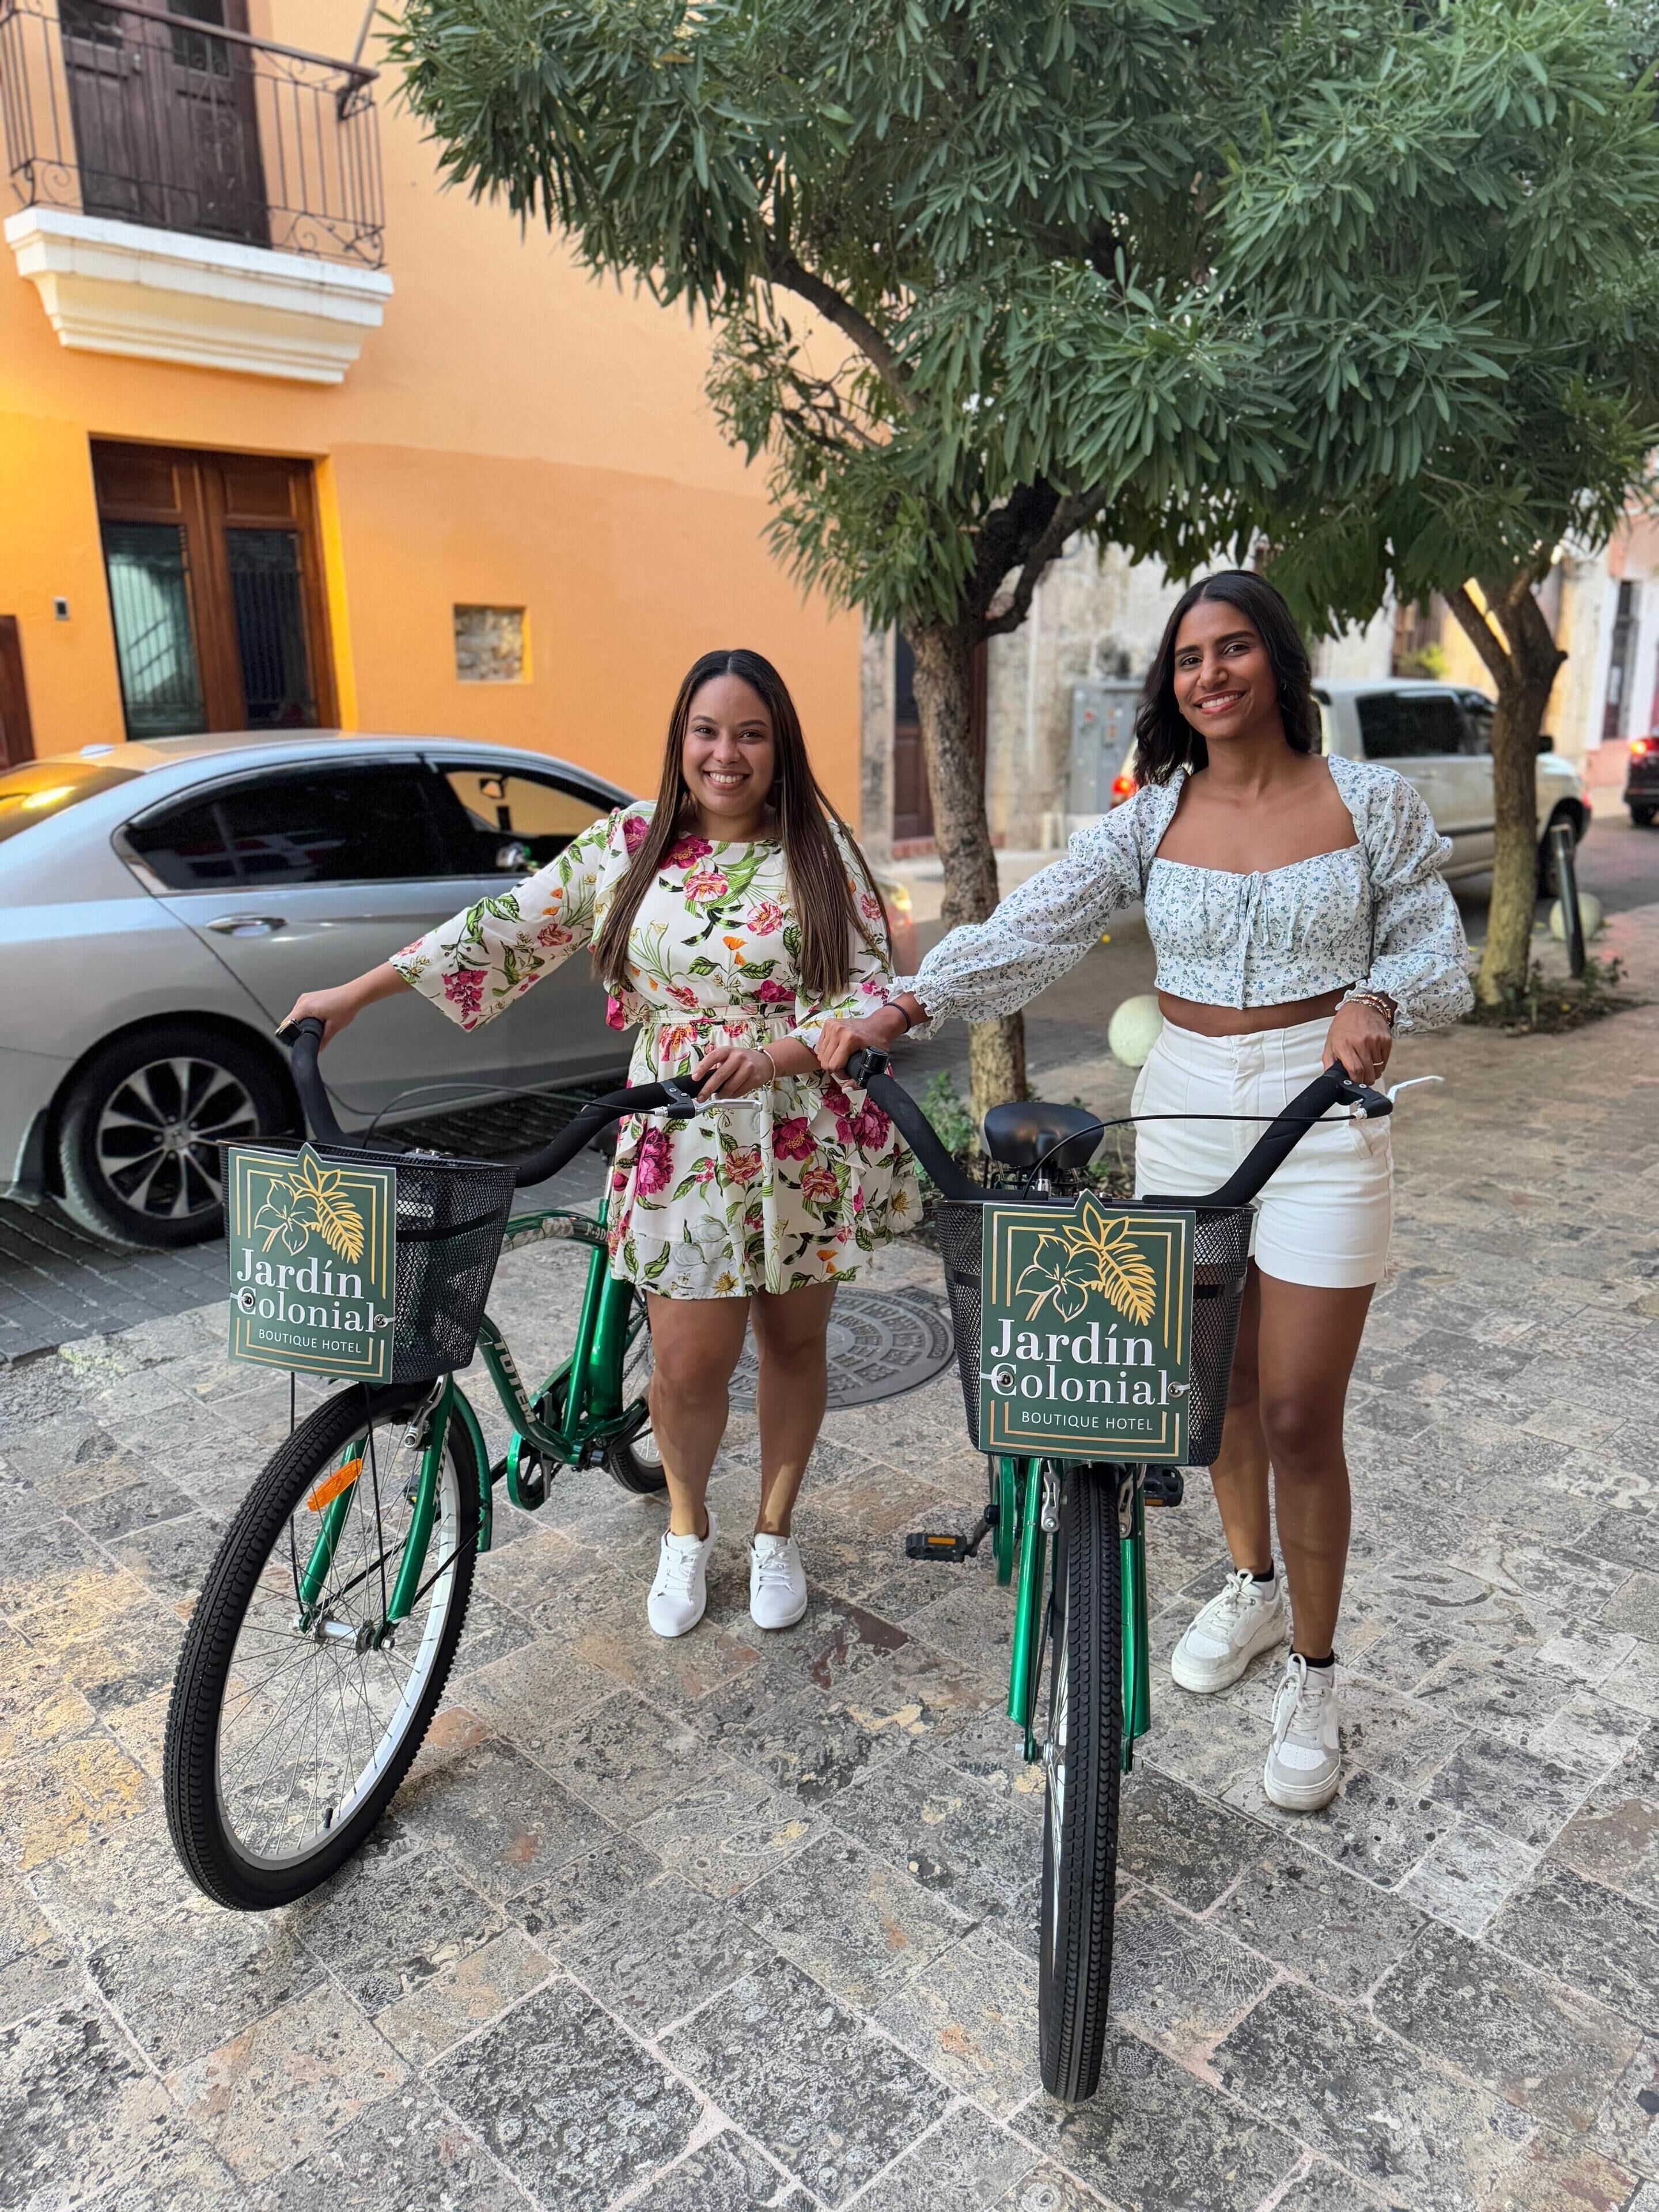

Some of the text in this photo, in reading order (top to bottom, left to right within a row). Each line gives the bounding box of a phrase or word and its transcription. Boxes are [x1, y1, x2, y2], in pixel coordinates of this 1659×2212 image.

[237, 1248, 364, 1299] Jardín
[237, 1286, 376, 1333] Colonial
[259, 1328, 362, 1353] BOUTIQUE HOTEL
[933, 1325, 947, 1357] DOMINGO
[990, 1318, 1156, 1366] Jardín
[494, 1335, 536, 1423] TOTEM
[991, 1362, 1169, 1405] Colonial
[1021, 1411, 1153, 1430] BOUTIQUE HOTEL
